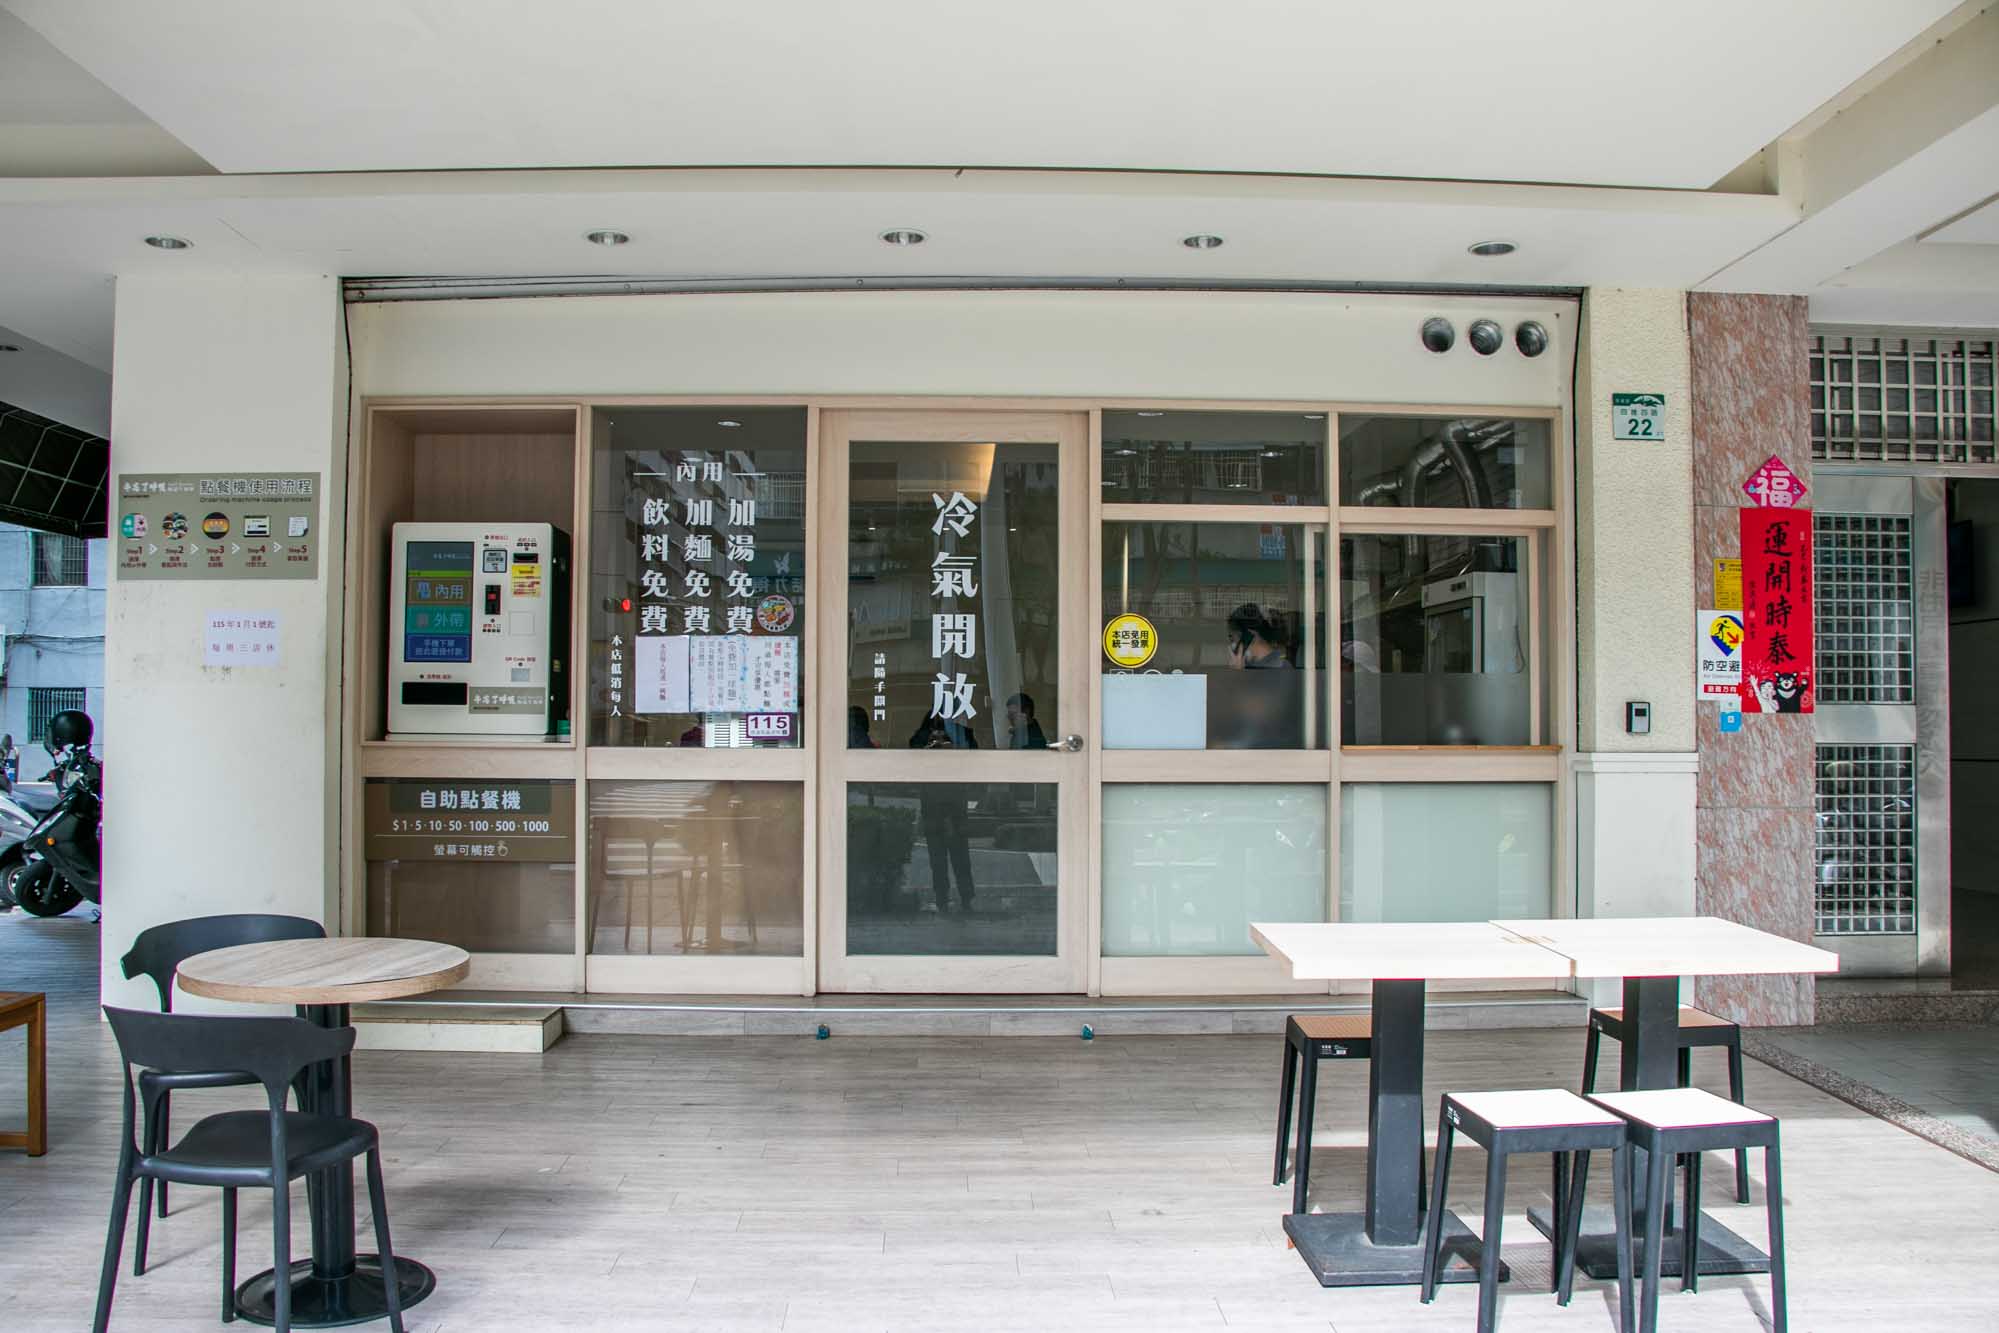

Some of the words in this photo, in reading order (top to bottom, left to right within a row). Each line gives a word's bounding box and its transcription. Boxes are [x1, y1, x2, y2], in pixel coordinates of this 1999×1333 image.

[1628, 418, 1652, 436] 22
[676, 462, 722, 482] 內用
[200, 479, 313, 495] 點餐機使用流程
[1756, 468, 1793, 507] 福
[641, 498, 670, 633] 飲料免費
[684, 498, 713, 633] 加麵免費
[727, 498, 756, 633] 加湯免費
[435, 583, 464, 600] 內用
[1763, 520, 1796, 665] 運開時泰
[930, 491, 978, 720] 冷氣開放
[1112, 631, 1149, 639] 本店免用
[1112, 639, 1149, 648] 統一發票
[611, 634, 623, 717] 本店低消每人
[873, 652, 886, 720] 請隨手關門
[751, 717, 787, 729] 115
[420, 790, 520, 810] 自助點餐機
[434, 844, 495, 857] 螢幕可觸控
